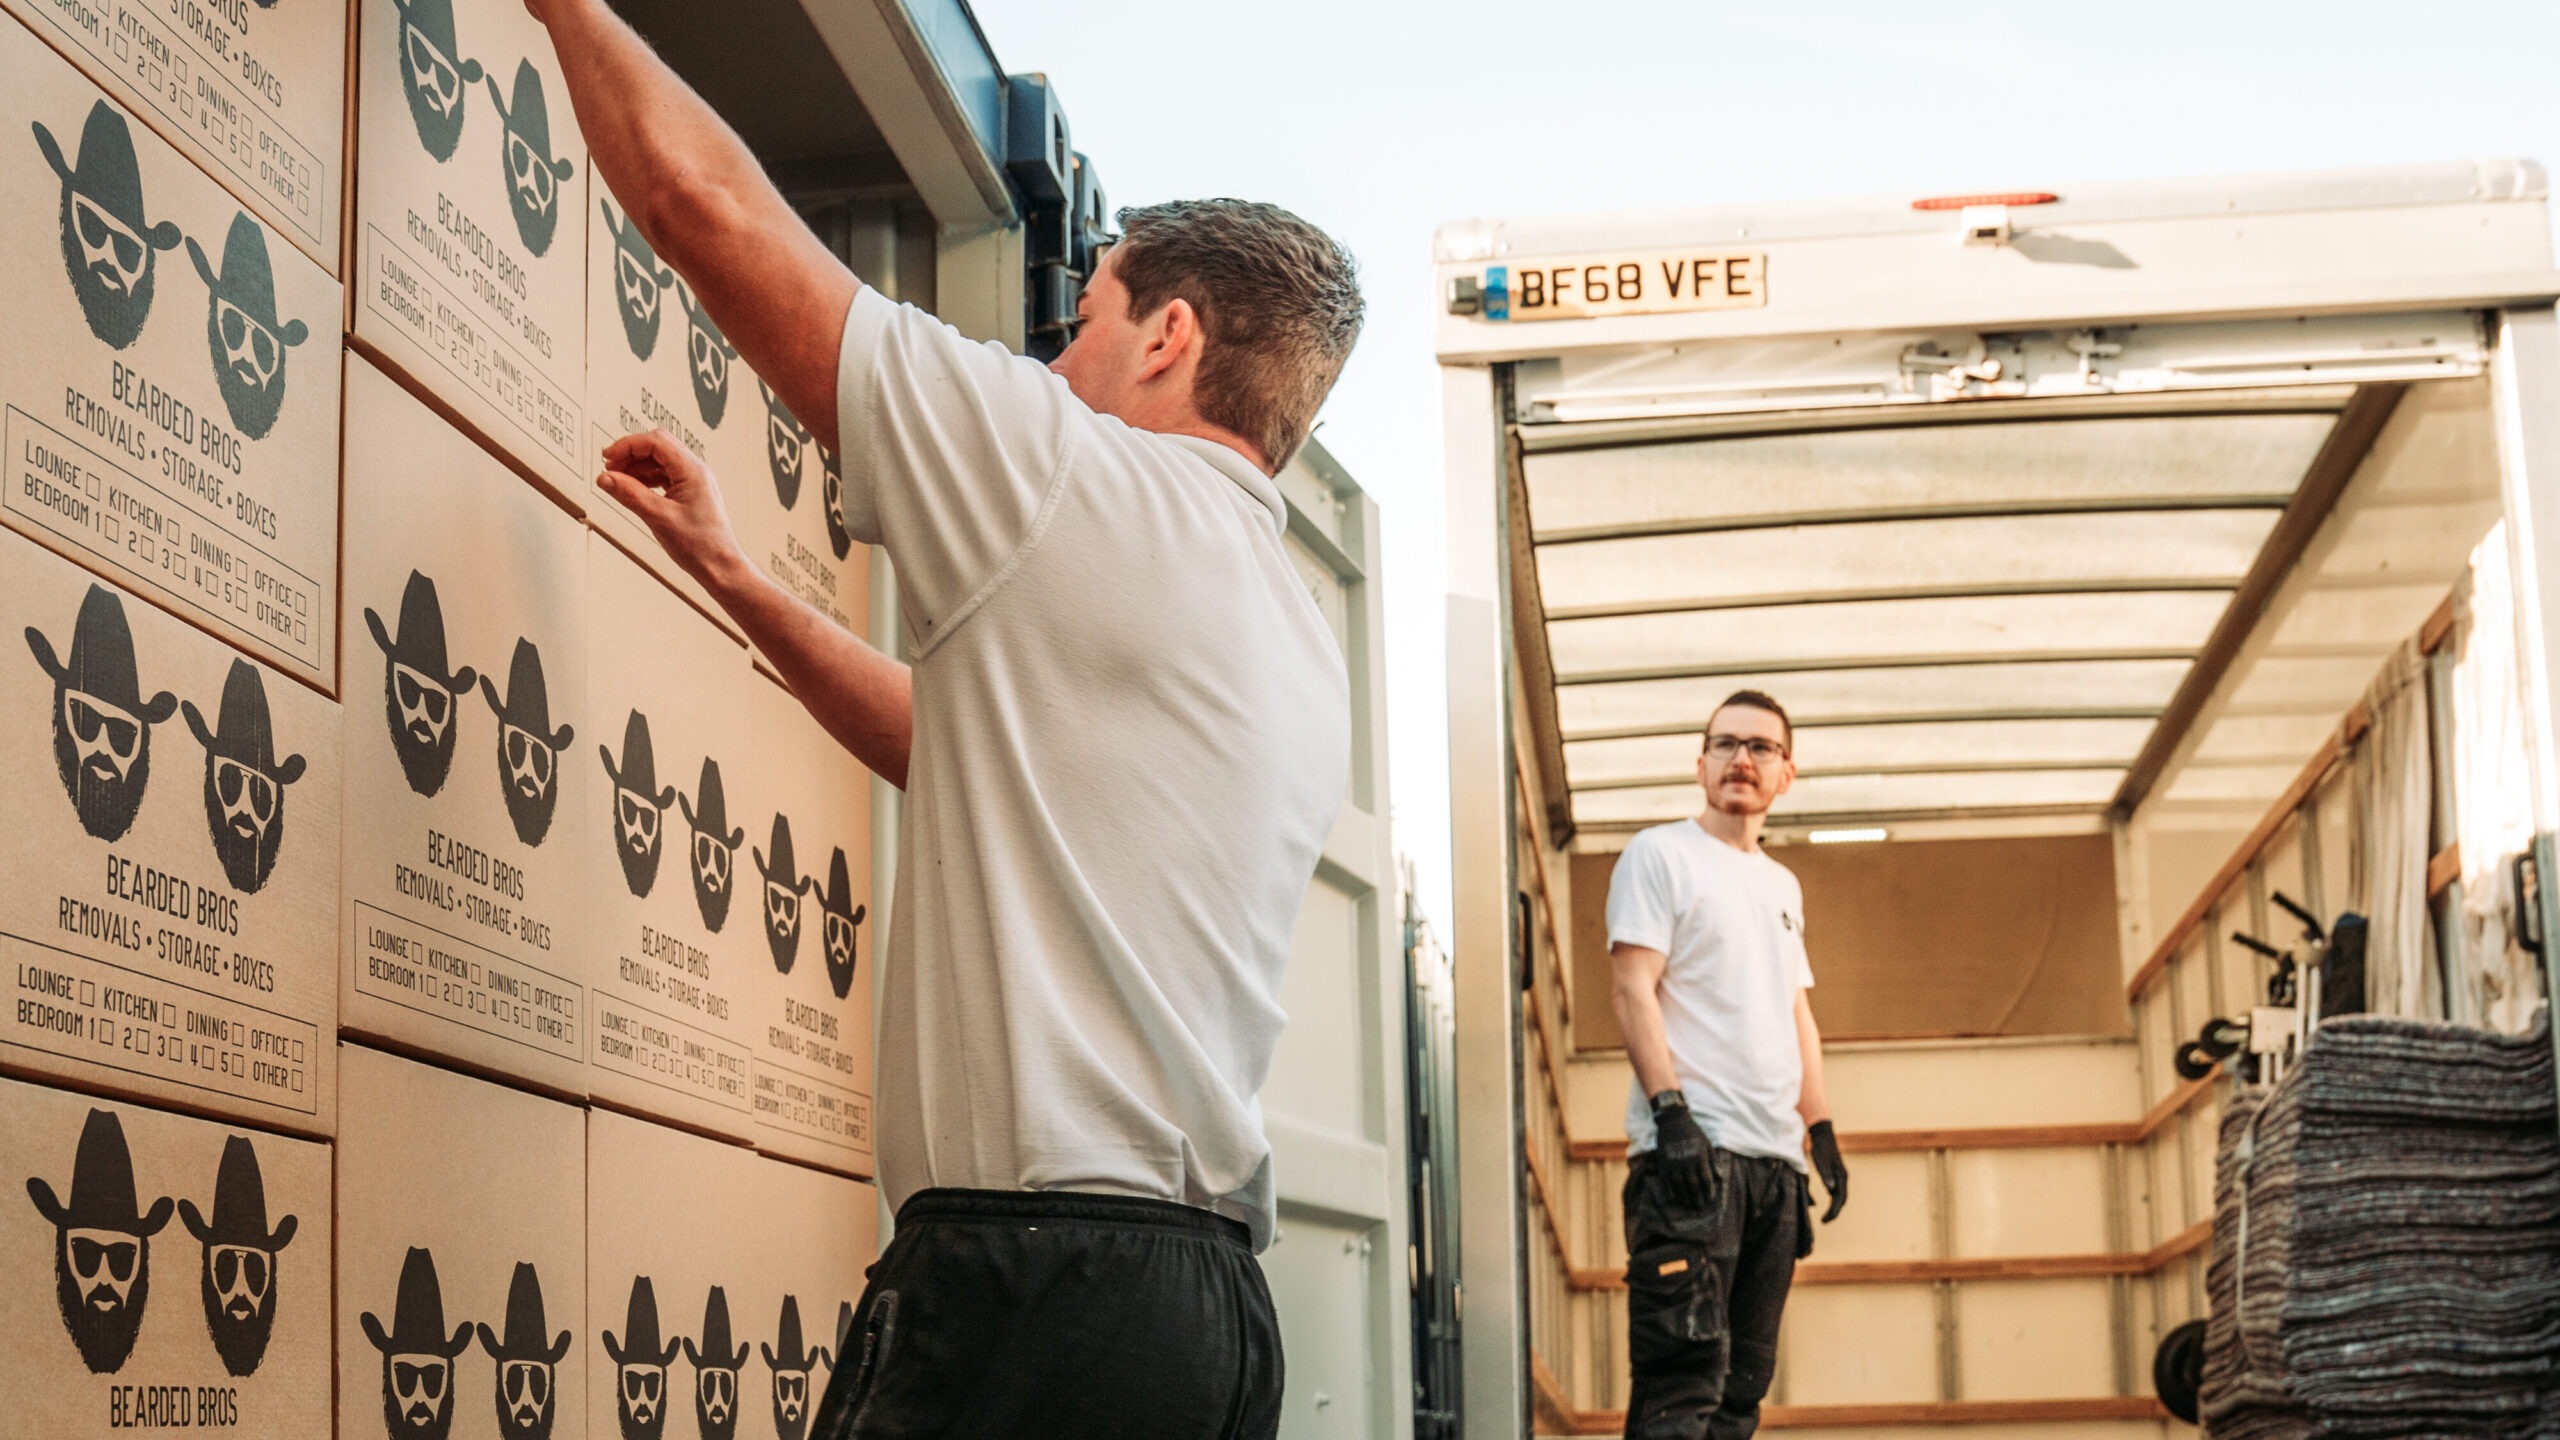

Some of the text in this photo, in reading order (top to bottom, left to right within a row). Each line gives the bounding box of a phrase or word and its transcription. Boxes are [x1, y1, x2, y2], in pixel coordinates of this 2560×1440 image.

[105, 27, 110, 47] 1
[137, 55, 145, 78] 2
[169, 82, 177, 103] 3
[201, 108, 208, 130] 4
[230, 132, 237, 154] 5
[260, 160, 294, 204] OTHER
[119, 7, 295, 177] KITCHEN DINING OFFICE
[243, 51, 282, 107] BOXES
[407, 208, 552, 360] REMOVALS STORAGE BOXES
[438, 191, 526, 301] BEARDED BROS
[1519, 258, 1752, 309] BF68 VFE
[381, 254, 564, 424] LOUNGE KITCHEN DINING OFFICE
[381, 282, 564, 449] BEDROOM 1 2 3 4 5 OTHER
[112, 360, 241, 475] BEARDED BROS
[66, 386, 276, 541] REMOVALS STORAGE BOXES
[24, 472, 291, 636] BEDROOM 1 2 3 4 5 OTHER
[26, 439, 292, 607] LOUNGE KITCHEN DINING OFFICE
[787, 533, 836, 597] BEARDED BROS
[771, 552, 800, 593] REMOVALS
[107, 854, 239, 936] BEARDED BROS
[396, 864, 550, 951] REMOVALS STORAGE BOXES
[428, 829, 524, 901] BEARDED BROS
[59, 896, 274, 993] REMOVALS STORAGE BOXES
[369, 926, 563, 1014] LOUNGE KITCHEN DINING OFFICE
[620, 956, 728, 1021] REMOVALS STORAGE BOXES
[642, 925, 709, 981] BEARDED BROS
[18, 963, 289, 1059] LOUNGE KITCHEN DINING OFFICE
[369, 956, 562, 1040] BEDROOM 1 2 3 4 5 OTHER
[601, 1010, 737, 1074] LOUNGE KITCHEN DINING OFFICE
[17, 998, 288, 1089] BEDROOM 1 2 3 4 5 OTHER
[601, 1034, 737, 1096] BEDROOM 1 2 3 4 5 OTHER
[110, 1385, 238, 1428] BEARDED BROS
